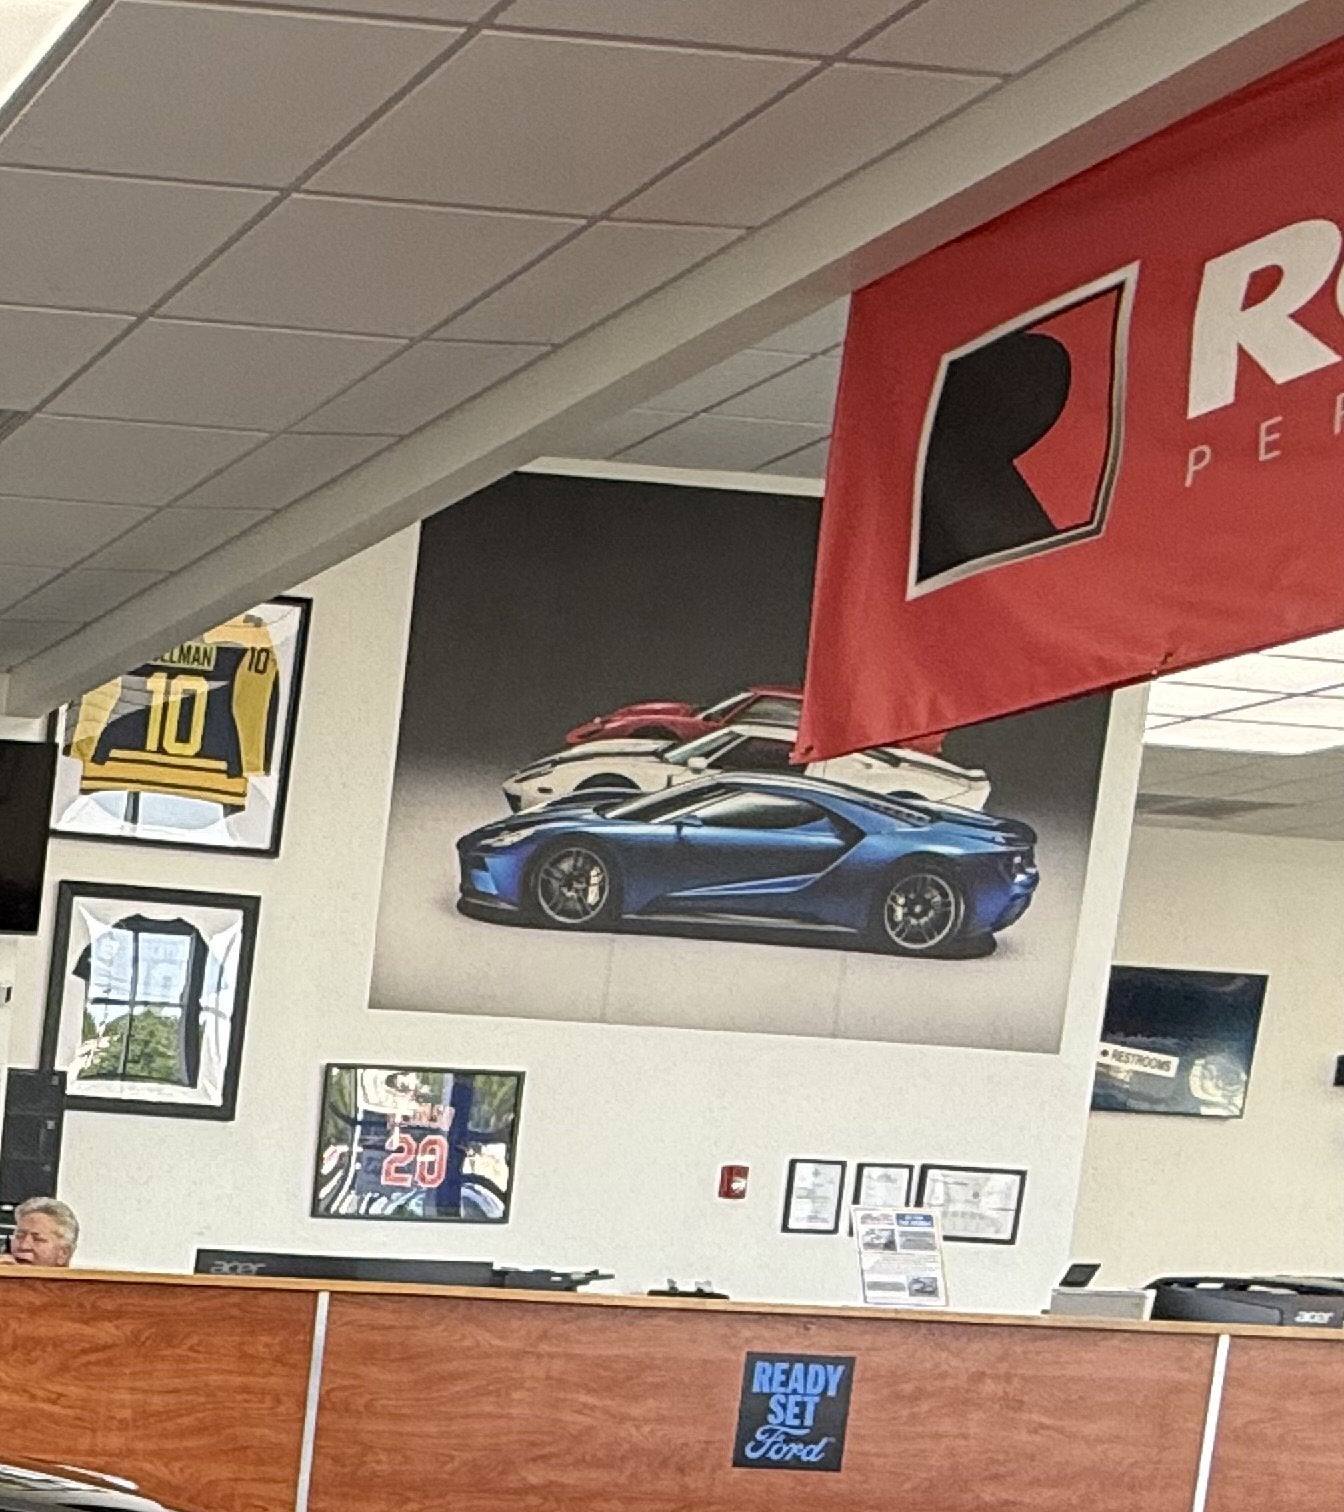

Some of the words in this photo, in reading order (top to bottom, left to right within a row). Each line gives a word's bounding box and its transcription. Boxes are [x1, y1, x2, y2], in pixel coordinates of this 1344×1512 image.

[1185, 217, 1344, 420] R
[1184, 392, 1344, 488] PE
[153, 643, 212, 668] LMAN
[246, 646, 270, 675] 10
[145, 672, 209, 756] 10
[1112, 1048, 1172, 1072] RESTROOMS
[380, 1133, 449, 1187] 20
[210, 1260, 267, 1275] acer
[1294, 1311, 1334, 1324] acer
[752, 1360, 846, 1397] READY
[767, 1394, 820, 1426] SET
[744, 1425, 827, 1462] Ford
